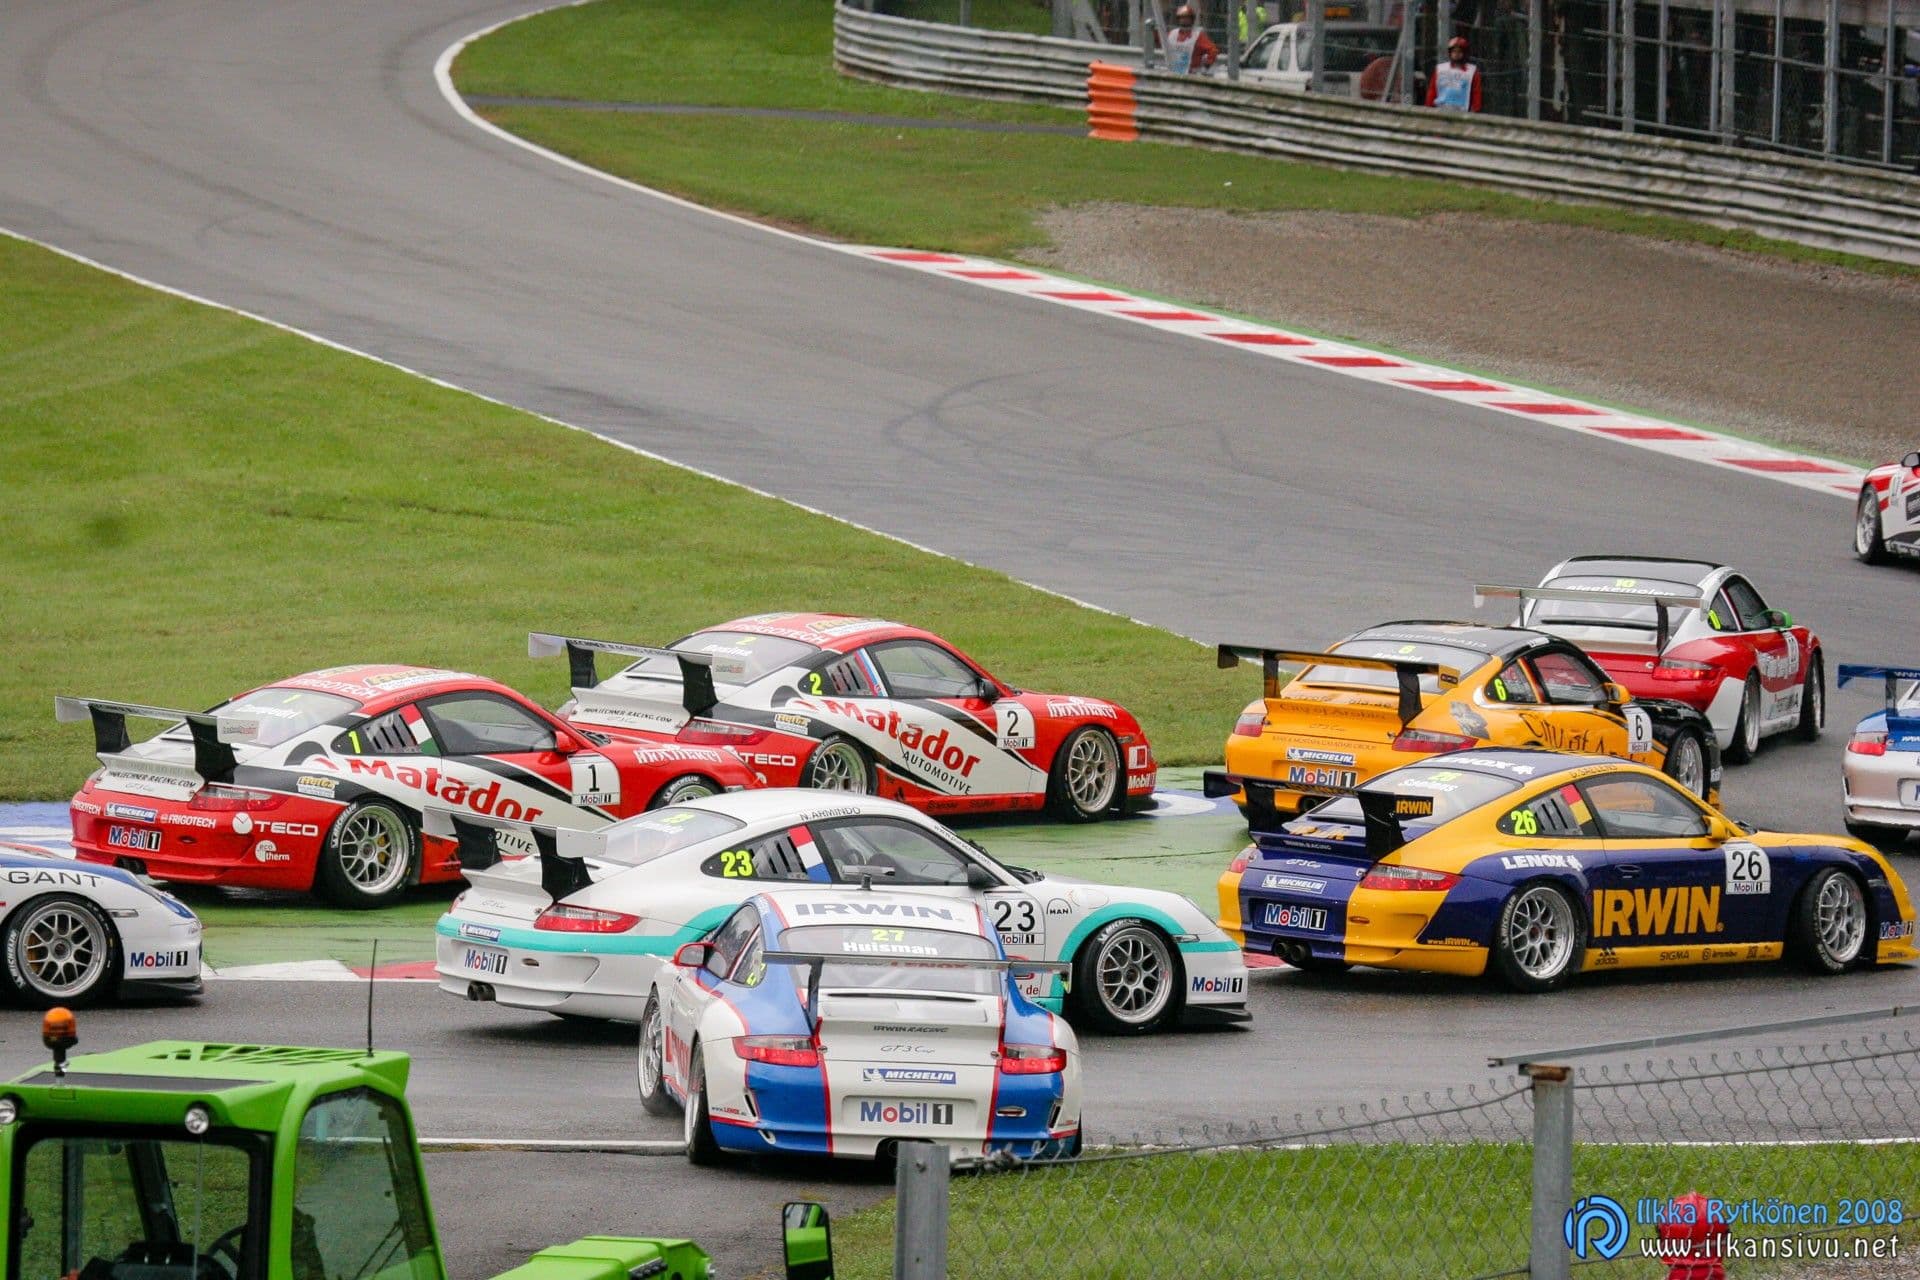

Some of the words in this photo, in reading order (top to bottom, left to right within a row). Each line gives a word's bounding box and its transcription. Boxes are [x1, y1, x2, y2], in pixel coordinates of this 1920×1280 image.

[809, 672, 823, 696] 2
[1494, 678, 1507, 701] 6
[1006, 710, 1019, 737] 2
[1635, 714, 1644, 741] 6
[348, 730, 361, 754] 1
[821, 699, 981, 778] Matador
[1003, 738, 1021, 748] Mobil
[742, 751, 796, 767] TECO
[1303, 751, 1353, 763] MICHELIN
[588, 763, 600, 793] 1
[902, 750, 973, 796] AUTOMOTIVE
[1127, 773, 1150, 789] Mobil
[1289, 766, 1338, 785] Mobil
[345, 757, 544, 823] Matador
[580, 794, 603, 804] Mobil
[114, 806, 155, 821] MICHELIN
[1395, 801, 1432, 815] IRWIN
[167, 813, 217, 829] FRIGOTECH
[253, 820, 319, 837] TECO
[1510, 809, 1537, 835] 26
[108, 825, 147, 850] Mobil
[149, 832, 160, 851] 1
[258, 843, 275, 851] eco
[265, 851, 290, 862] therm
[720, 850, 753, 878] 23
[1501, 854, 1567, 871] LENOX
[1731, 850, 1763, 881] 26
[8, 870, 101, 888] GANT
[1277, 877, 1323, 890] MICHELIN
[1733, 881, 1754, 892] Mobil
[795, 903, 953, 921] IRWIN
[993, 900, 1036, 932] 23
[1264, 902, 1310, 929] Mobil
[1311, 909, 1325, 930] 1
[1591, 884, 1722, 939] IRWIN
[871, 928, 905, 943] 27
[1000, 934, 1024, 944] Mobil
[842, 941, 938, 956] Huisman
[1659, 950, 1690, 961] SIGMA
[130, 951, 173, 968] Mobil
[177, 950, 188, 967] 1
[464, 948, 496, 973] Mobil
[496, 954, 507, 975] 1
[1191, 976, 1231, 994] Mobil
[1232, 977, 1243, 993] 1
[907, 1026, 949, 1034] RACING
[880, 1044, 912, 1053] GT3
[884, 1070, 955, 1082] MICHELIN
[860, 1101, 928, 1125] Mobil
[934, 1104, 952, 1125] 1
